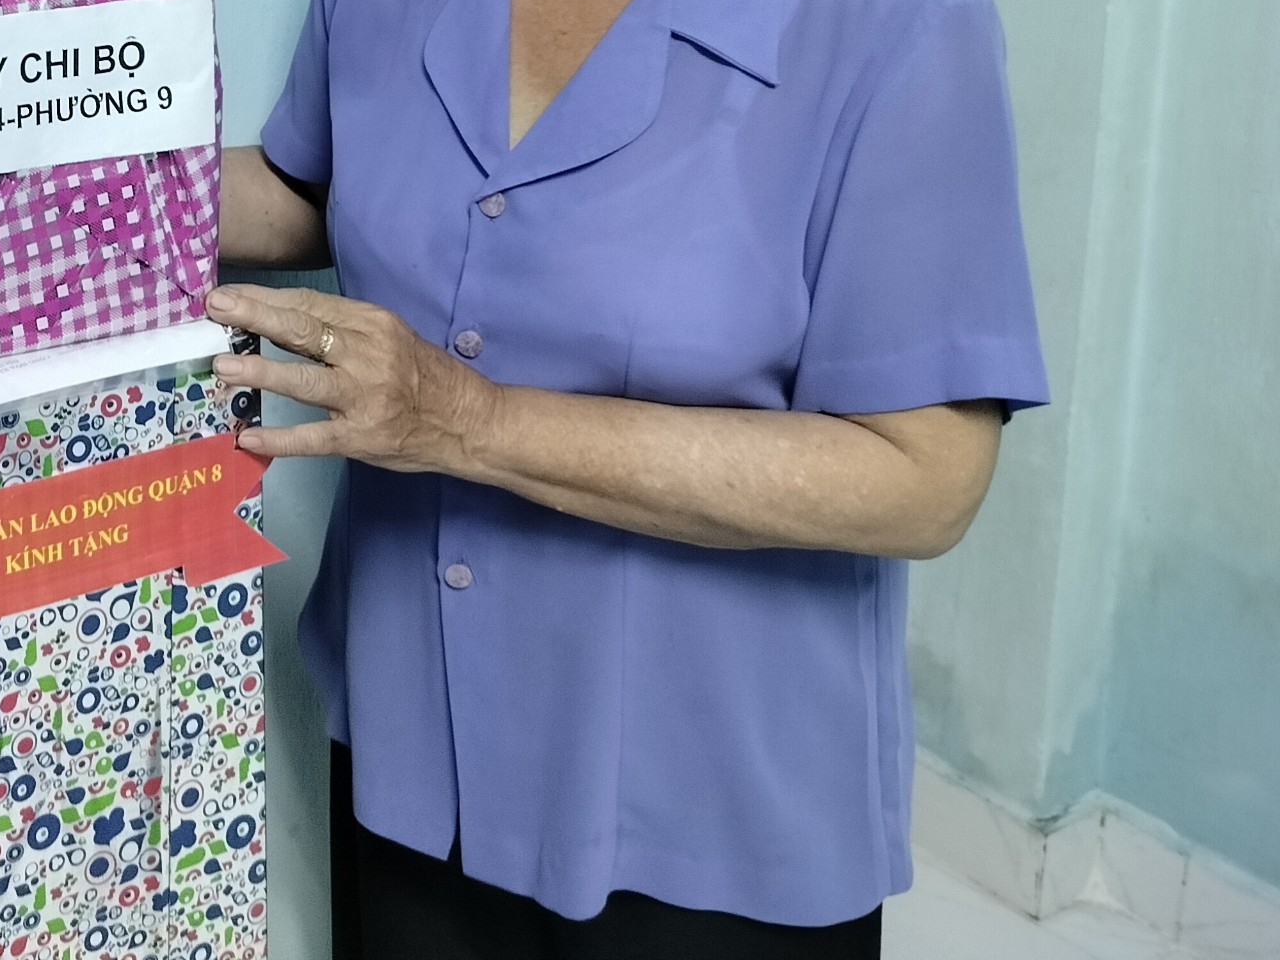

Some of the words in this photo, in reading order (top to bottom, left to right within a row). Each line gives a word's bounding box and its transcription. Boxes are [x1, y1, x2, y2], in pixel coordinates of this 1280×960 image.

[20, 48, 80, 83] CHI
[94, 36, 146, 79] BỘ
[158, 86, 173, 110] 9
[31, 504, 77, 533] LAO
[83, 485, 143, 519] ĐỘNG
[148, 468, 206, 501] QUẬN
[211, 463, 222, 482] 8
[5, 542, 63, 575] KÍNH
[69, 524, 129, 557] TẶNG
